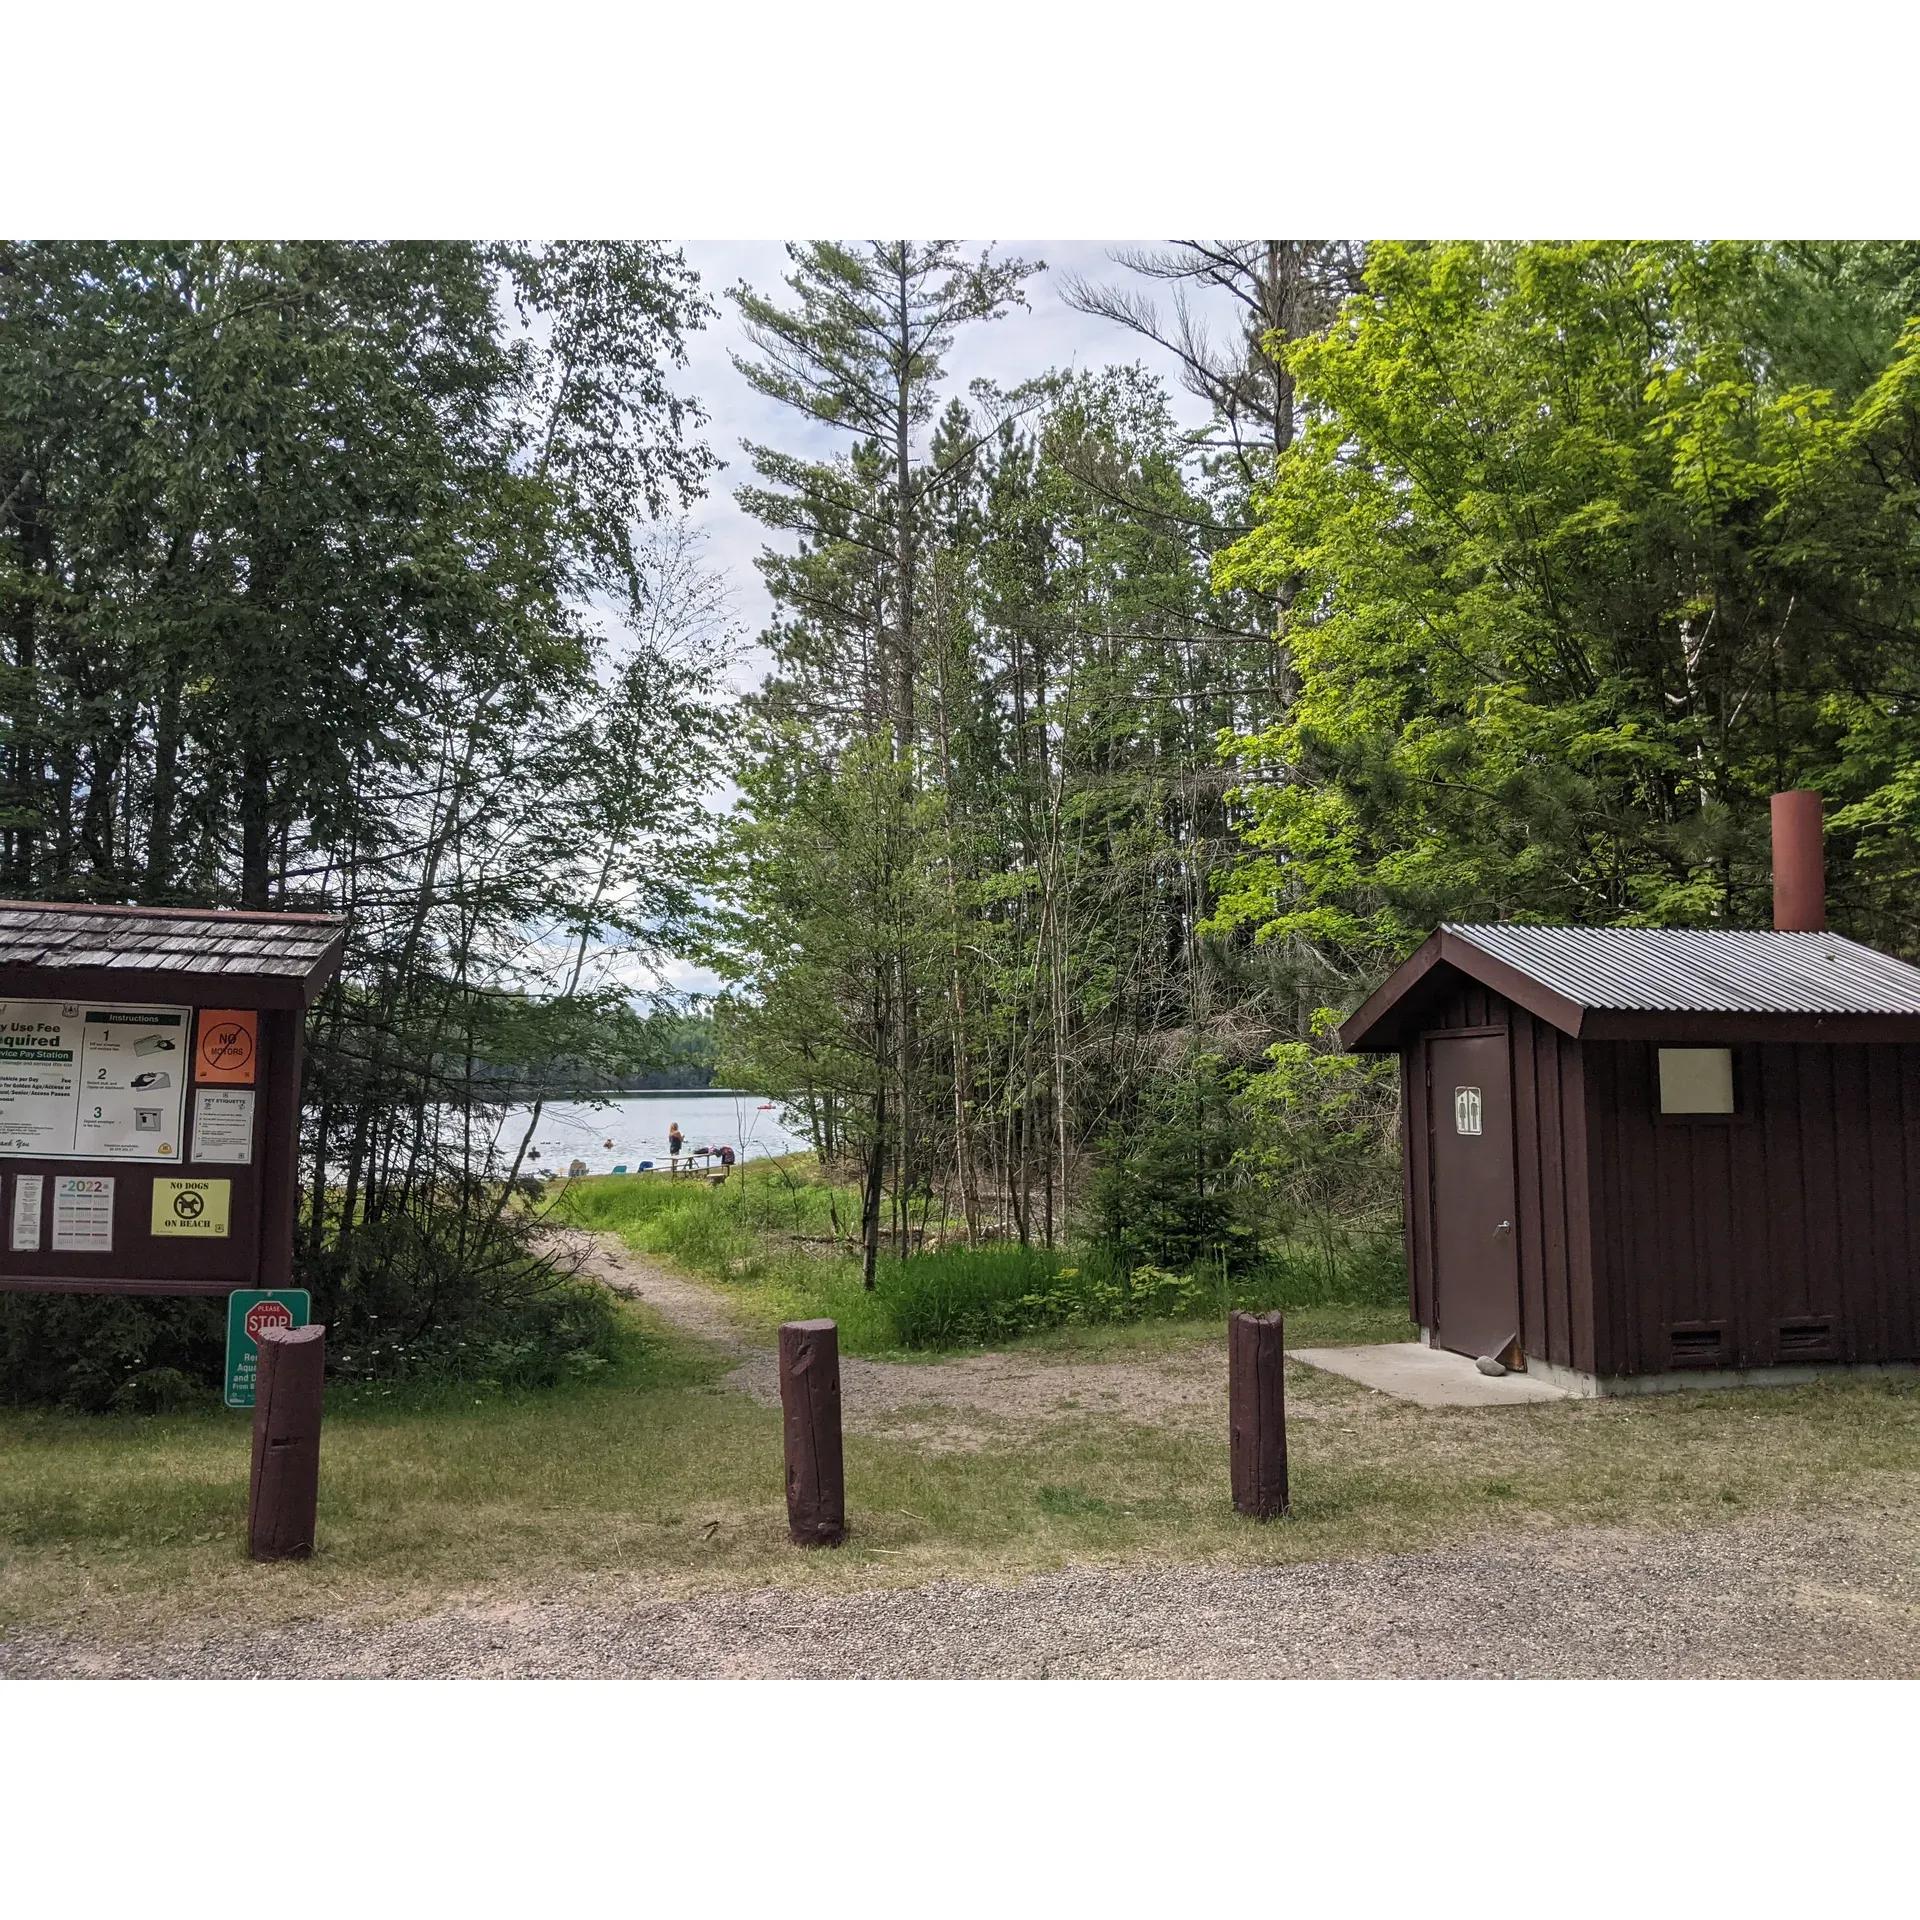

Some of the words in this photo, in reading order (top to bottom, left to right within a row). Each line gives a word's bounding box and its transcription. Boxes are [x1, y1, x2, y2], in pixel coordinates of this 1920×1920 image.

[109, 1014, 159, 1022] Instructions
[11, 1023, 34, 1032] Use
[37, 1023, 60, 1032] Fee
[0, 1034, 60, 1047] quired
[103, 1030, 109, 1041] 1
[219, 1033, 236, 1044] NO
[36, 1051, 69, 1059] Station
[98, 1068, 107, 1080] 2
[94, 1107, 102, 1118] 3
[15, 1139, 30, 1149] You
[68, 1180, 103, 1193] 2022
[170, 1182, 183, 1190] NO
[185, 1182, 209, 1190] DOGS
[164, 1220, 177, 1228] ON
[179, 1220, 211, 1228] BEACH
[249, 1315, 288, 1332] STOP
[233, 1374, 249, 1382] and
